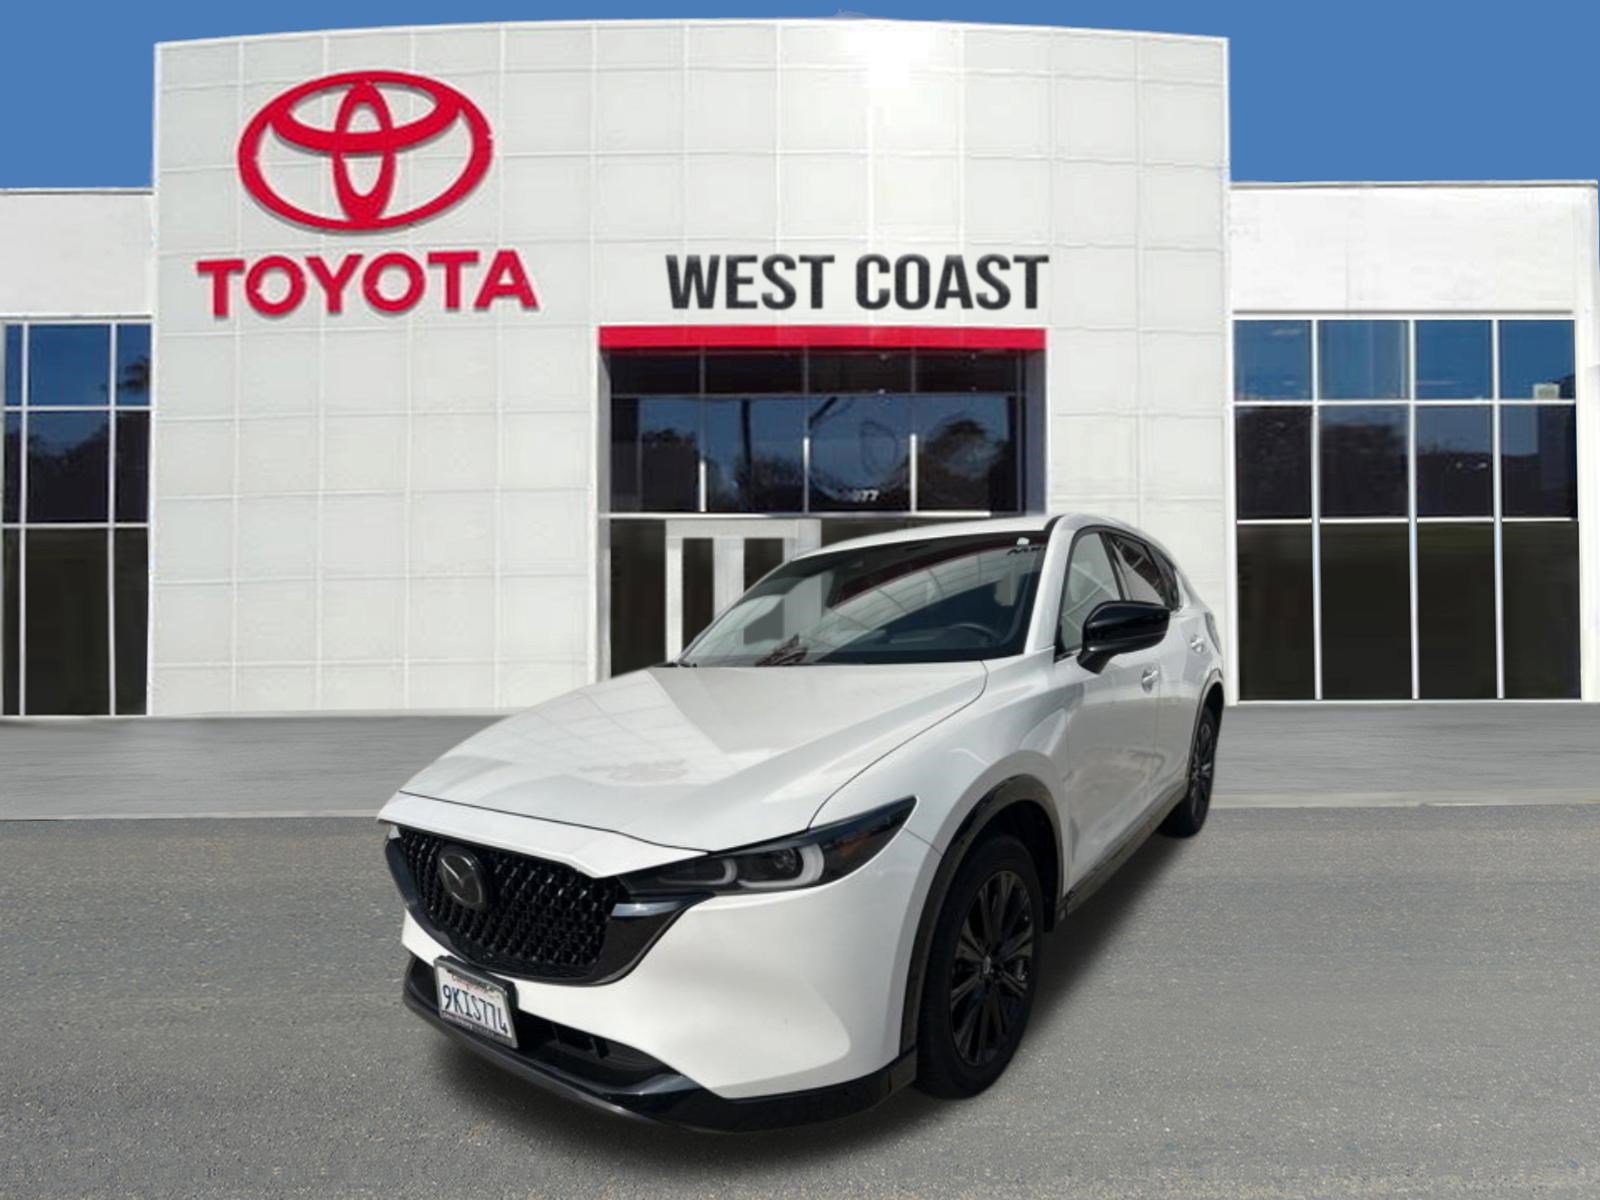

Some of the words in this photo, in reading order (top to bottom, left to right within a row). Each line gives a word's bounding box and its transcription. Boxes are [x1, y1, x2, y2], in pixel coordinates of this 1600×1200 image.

[197, 249, 539, 319] TOYOTA
[665, 253, 836, 310] WEST
[855, 253, 1050, 310] COAST
[442, 984, 509, 1035] 9KIS774
